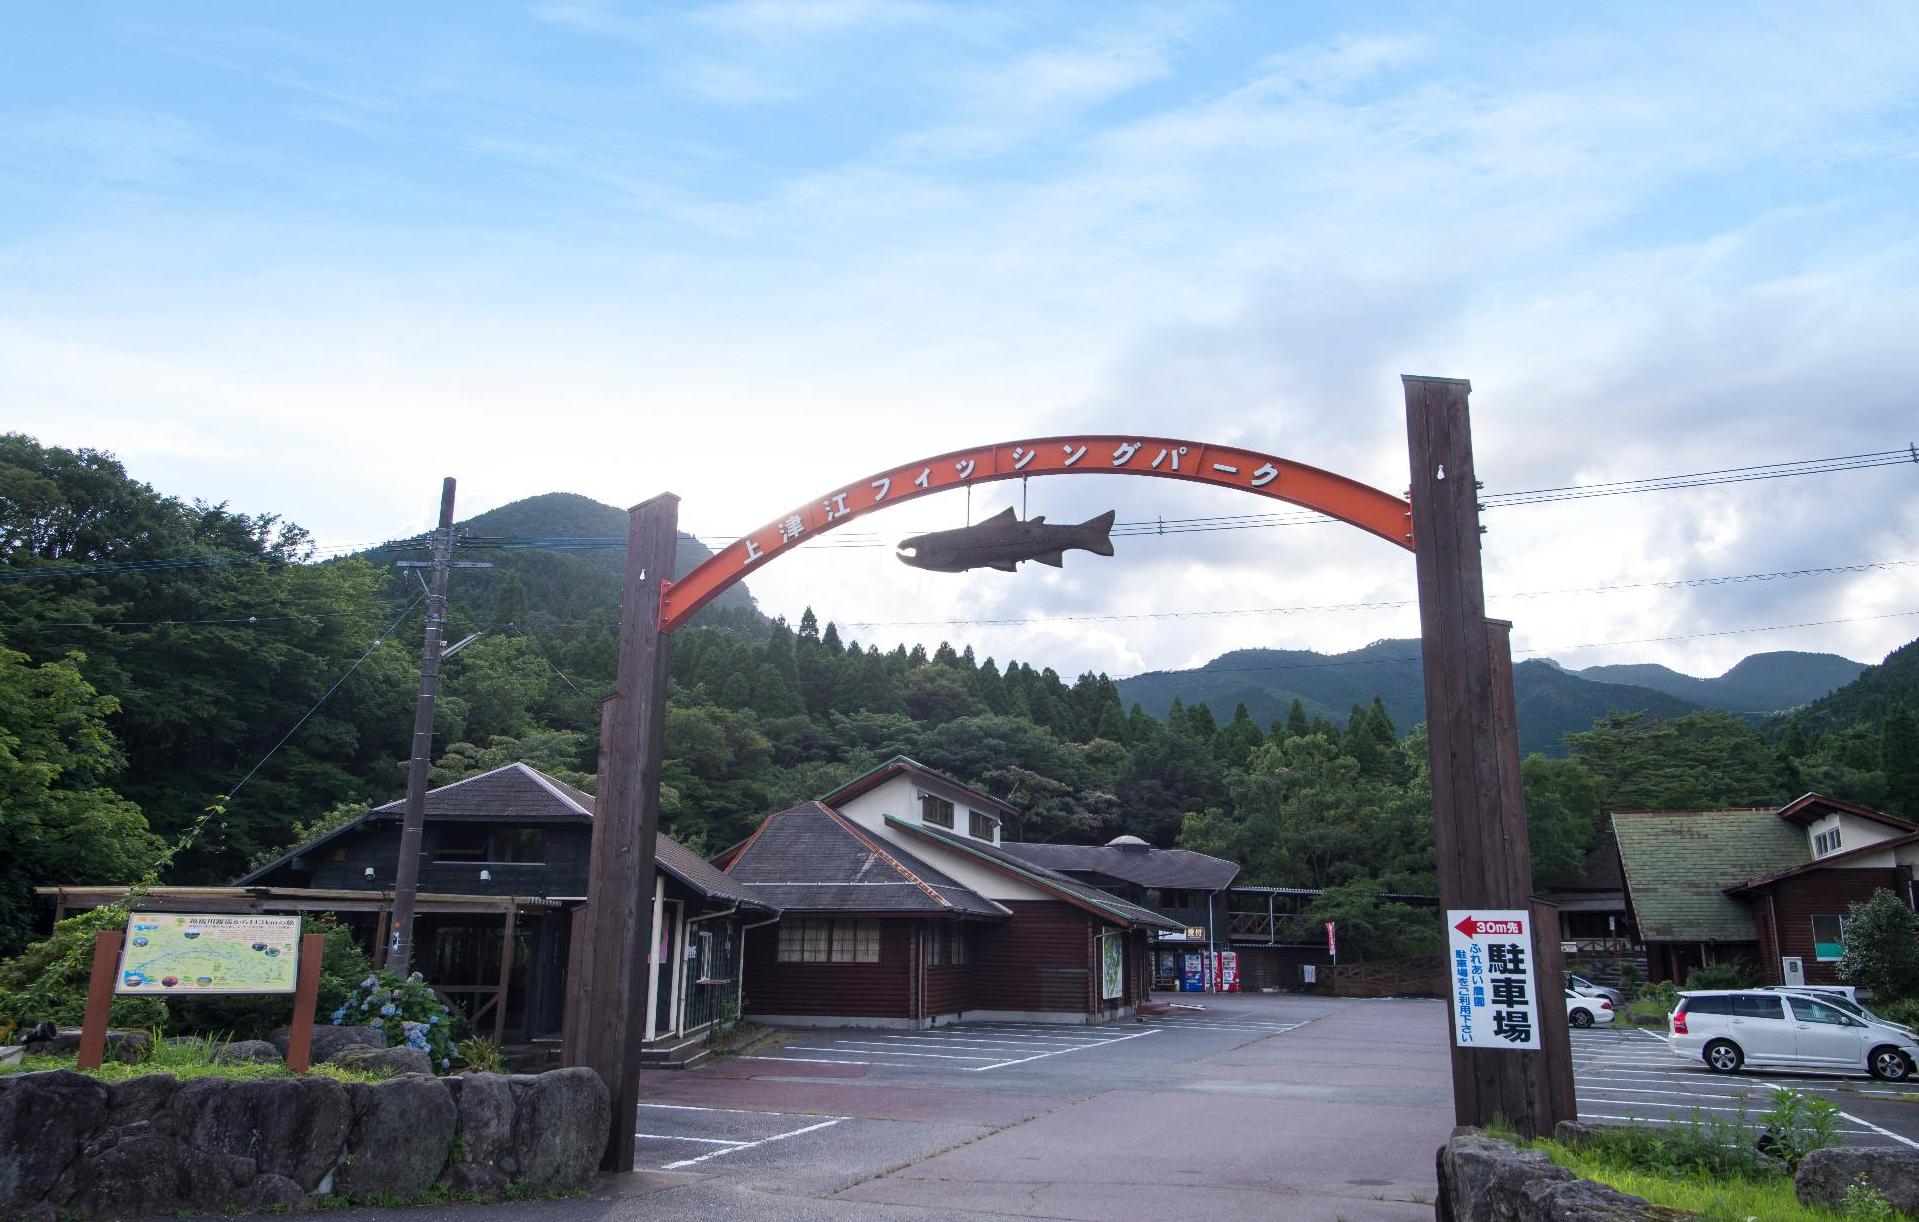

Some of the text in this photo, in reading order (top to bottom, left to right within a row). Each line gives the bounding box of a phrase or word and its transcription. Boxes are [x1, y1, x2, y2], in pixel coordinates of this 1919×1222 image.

[743, 441, 1280, 565] 上津江フィッシングパーク
[1476, 921, 1519, 934] 30m先
[1455, 949, 1473, 1042] 駐車場をご利用下さい
[1469, 943, 1485, 1007] ふれあい農園
[1487, 943, 1531, 1043] 駐車場
